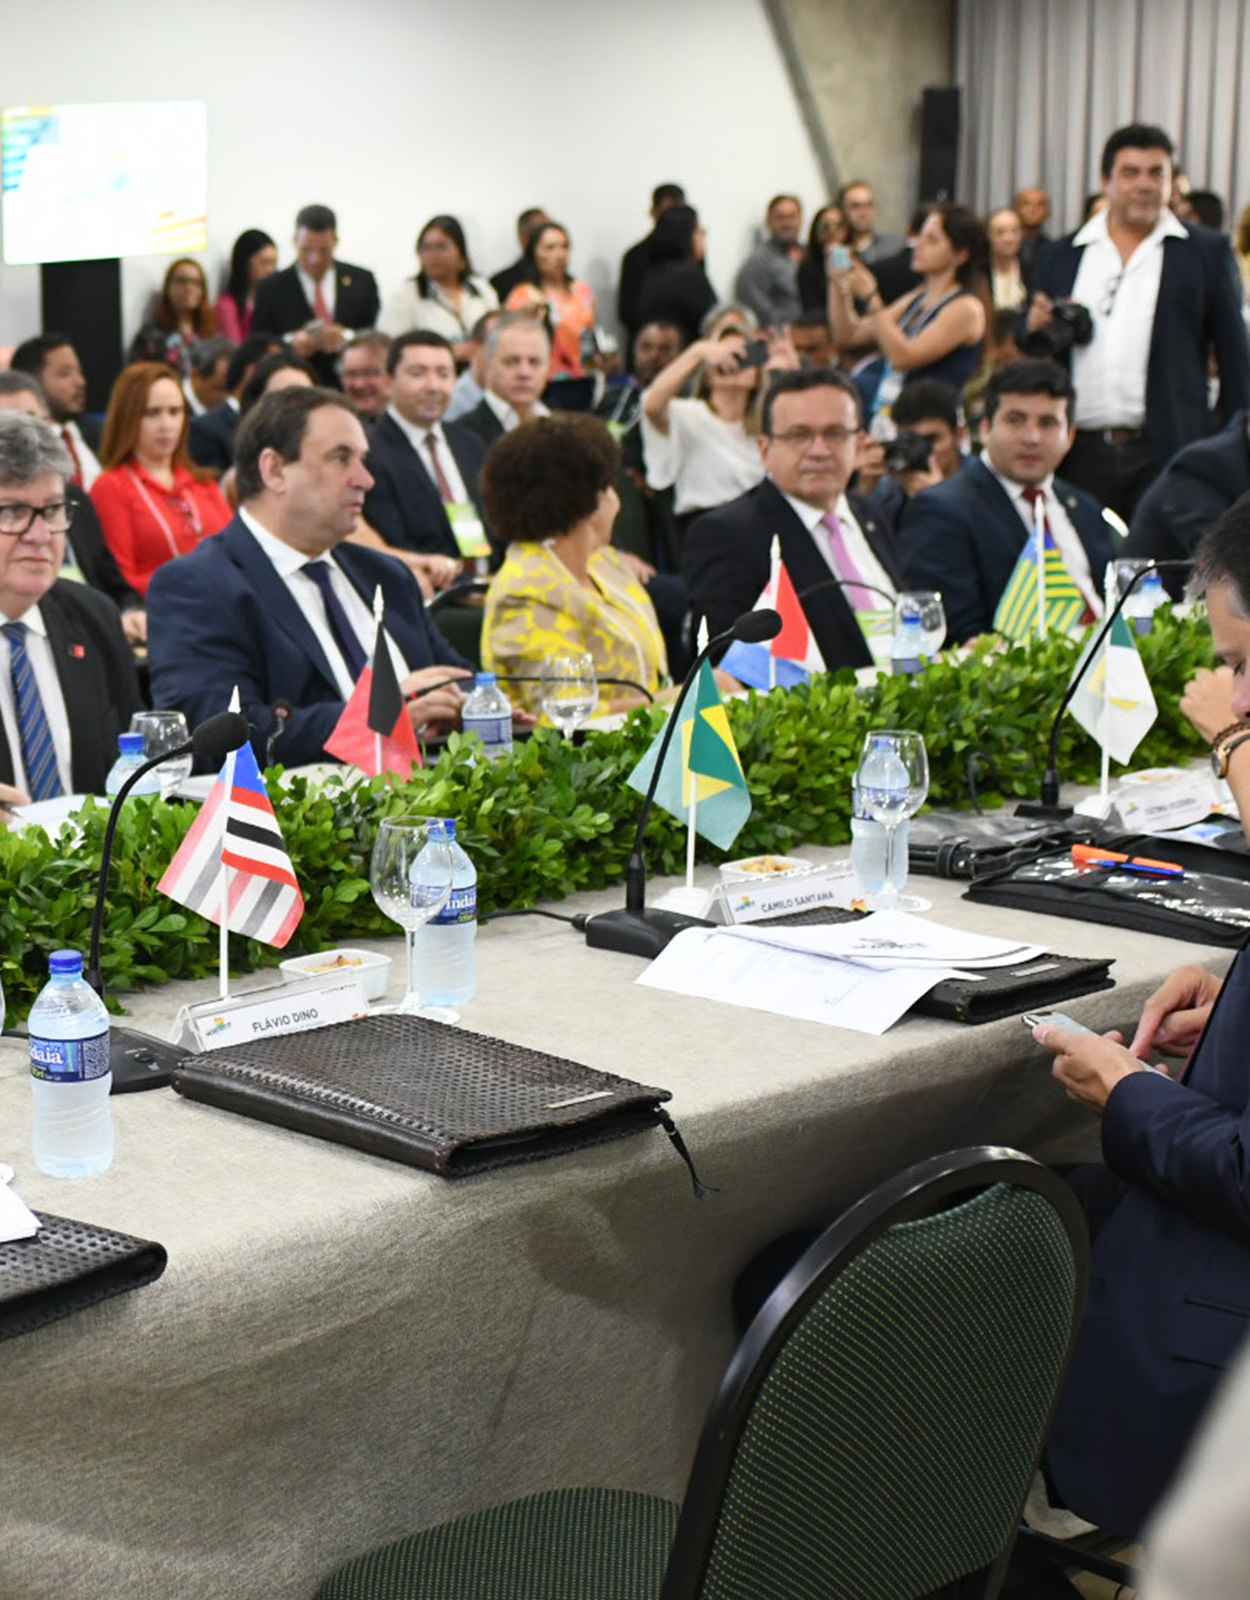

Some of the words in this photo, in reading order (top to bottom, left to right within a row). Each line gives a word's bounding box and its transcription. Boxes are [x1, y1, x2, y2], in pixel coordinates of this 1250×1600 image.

[761, 899, 794, 914] CAMILO
[794, 890, 834, 906] SANTANA
[252, 1014, 291, 1033] FLÁVIO
[292, 1008, 319, 1024] DINO
